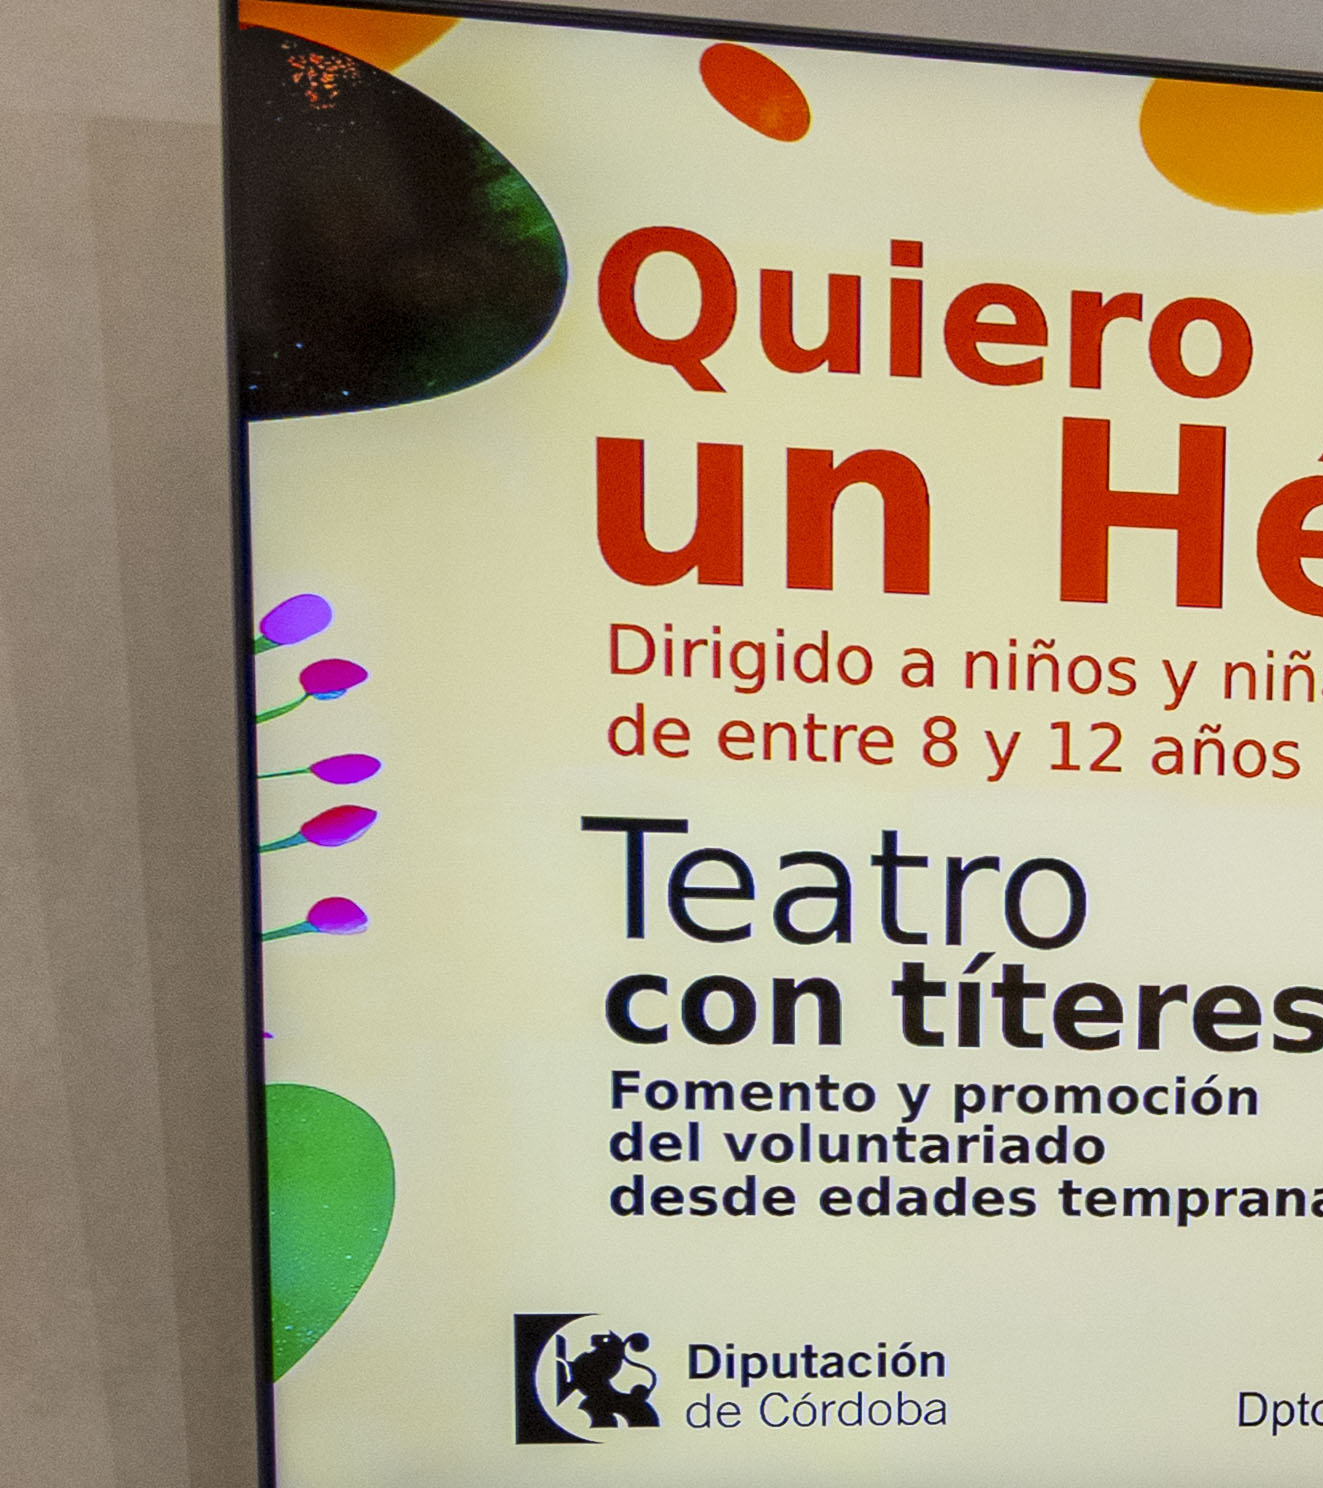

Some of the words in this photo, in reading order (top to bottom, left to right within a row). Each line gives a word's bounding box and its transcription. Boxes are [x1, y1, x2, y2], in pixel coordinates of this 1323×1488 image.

[598, 226, 1254, 399] Quiero
[596, 437, 930, 595] un
[611, 623, 872, 694] Dirigido
[902, 648, 933, 688] a
[966, 639, 1136, 696] niños
[1163, 660, 1197, 710] y
[608, 703, 690, 758] de
[718, 714, 893, 765] entre
[923, 716, 957, 767] 8
[985, 731, 1020, 782] y
[1051, 722, 1121, 772] 12
[1152, 724, 1300, 779] años
[581, 816, 1086, 950] Teatro
[606, 975, 841, 1045] con
[612, 1071, 875, 1112] Fomento
[898, 1084, 930, 1123] y
[955, 1074, 1257, 1121] promoción
[610, 1121, 699, 1162] del
[724, 1120, 1104, 1164] voluntariado
[611, 1175, 795, 1216] desde
[820, 1176, 1036, 1217] edades
[689, 1342, 944, 1387] Diputación
[687, 1393, 740, 1428] de
[760, 1391, 946, 1427] Córdoba
